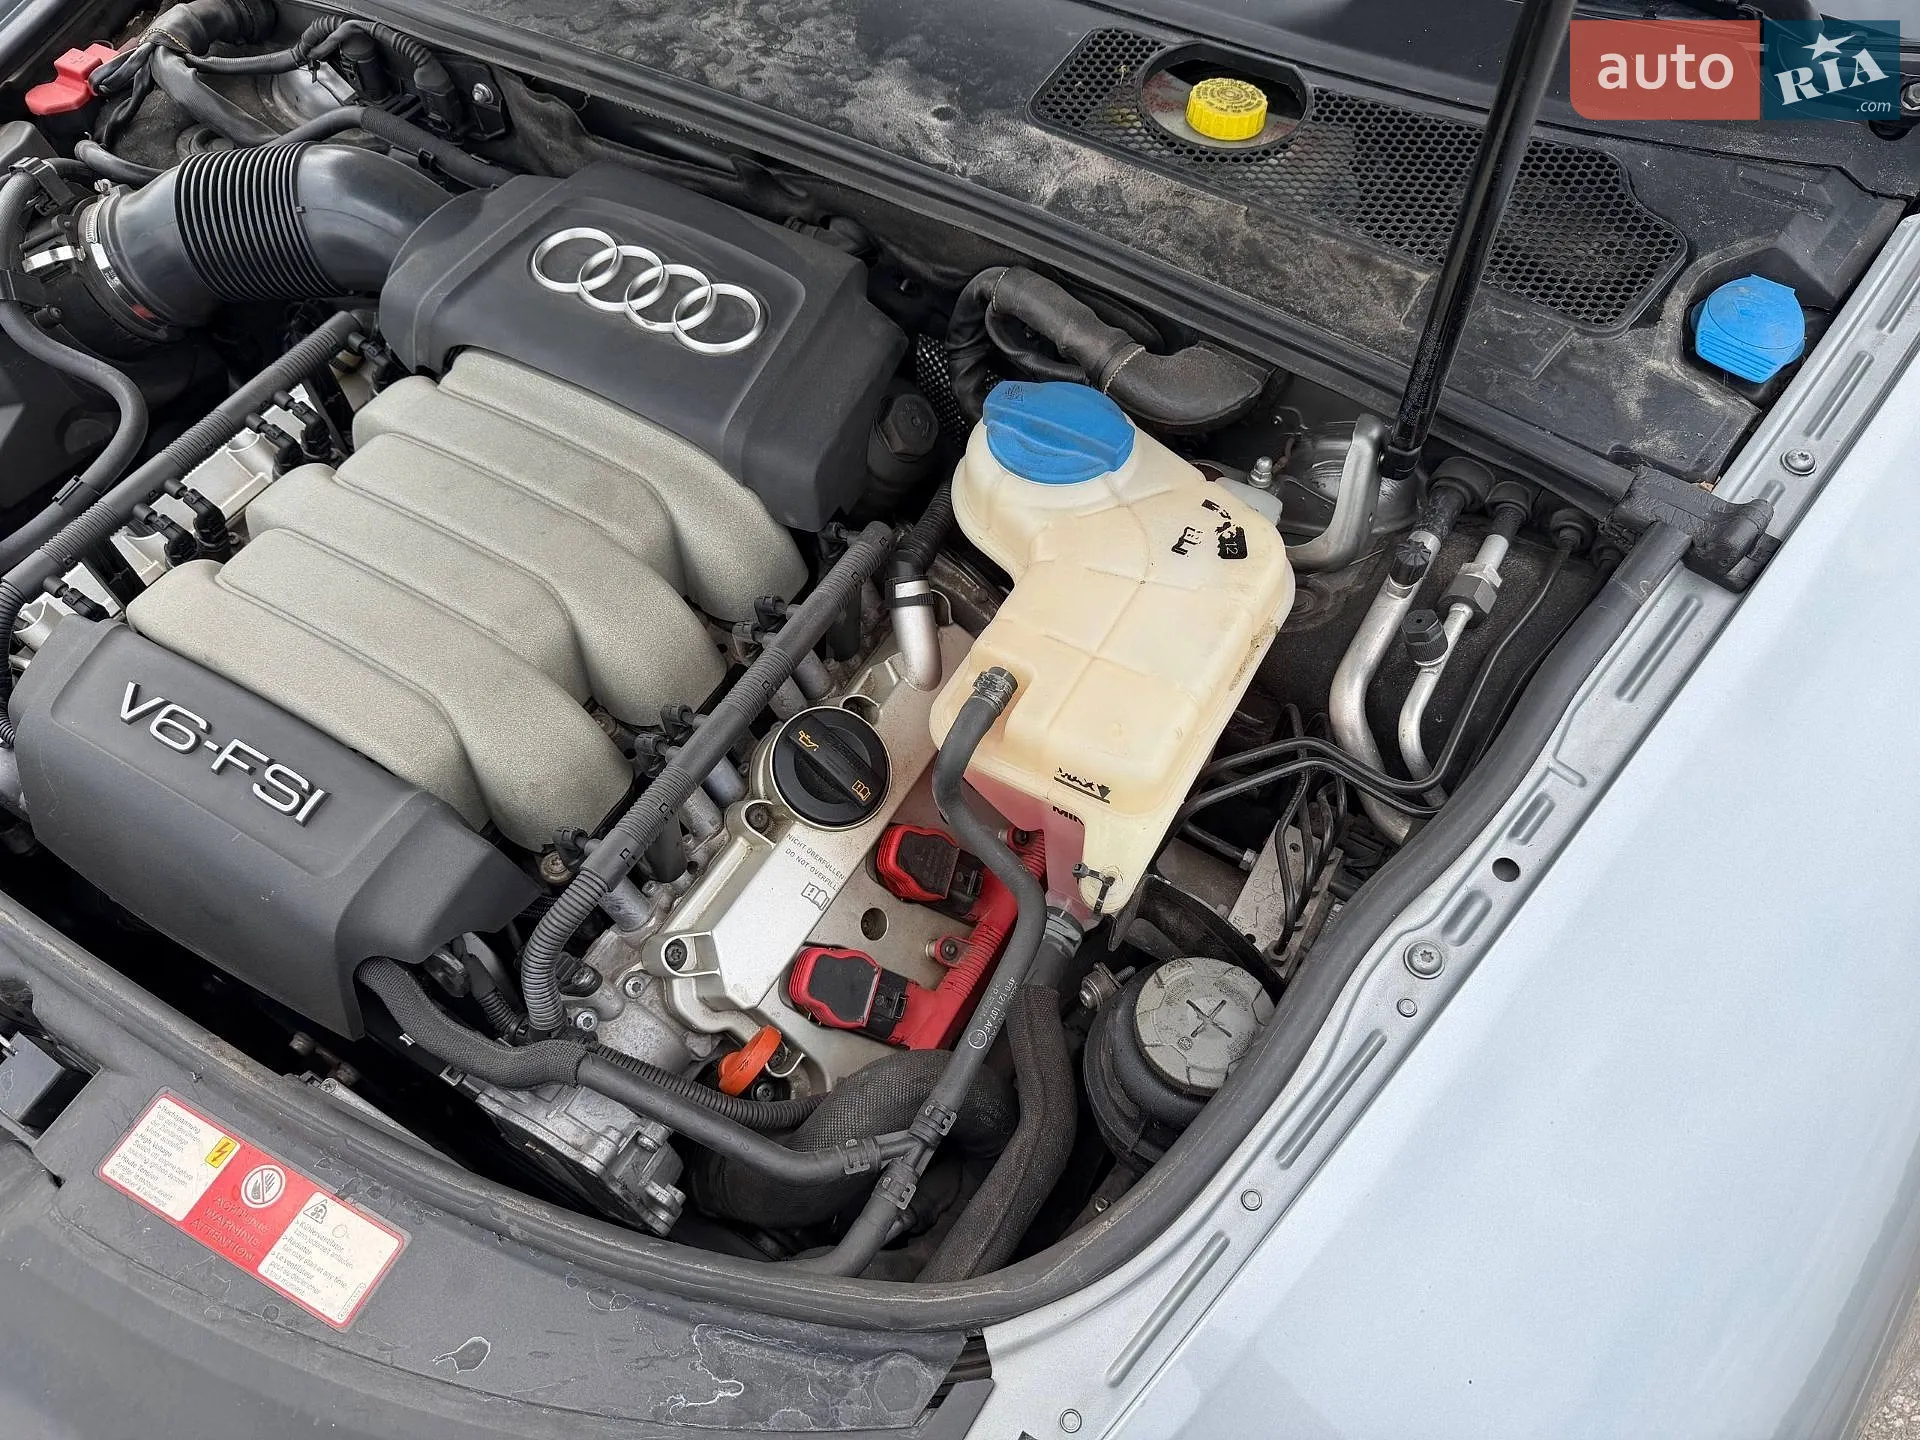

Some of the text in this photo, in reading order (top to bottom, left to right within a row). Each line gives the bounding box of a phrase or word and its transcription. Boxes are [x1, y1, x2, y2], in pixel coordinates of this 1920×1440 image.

[1224, 541, 1239, 555] 12
[119, 680, 332, 827] V6-FSI
[786, 833, 806, 850] NICHT
[784, 847, 796, 858] DO
[795, 856, 810, 868] NOT
